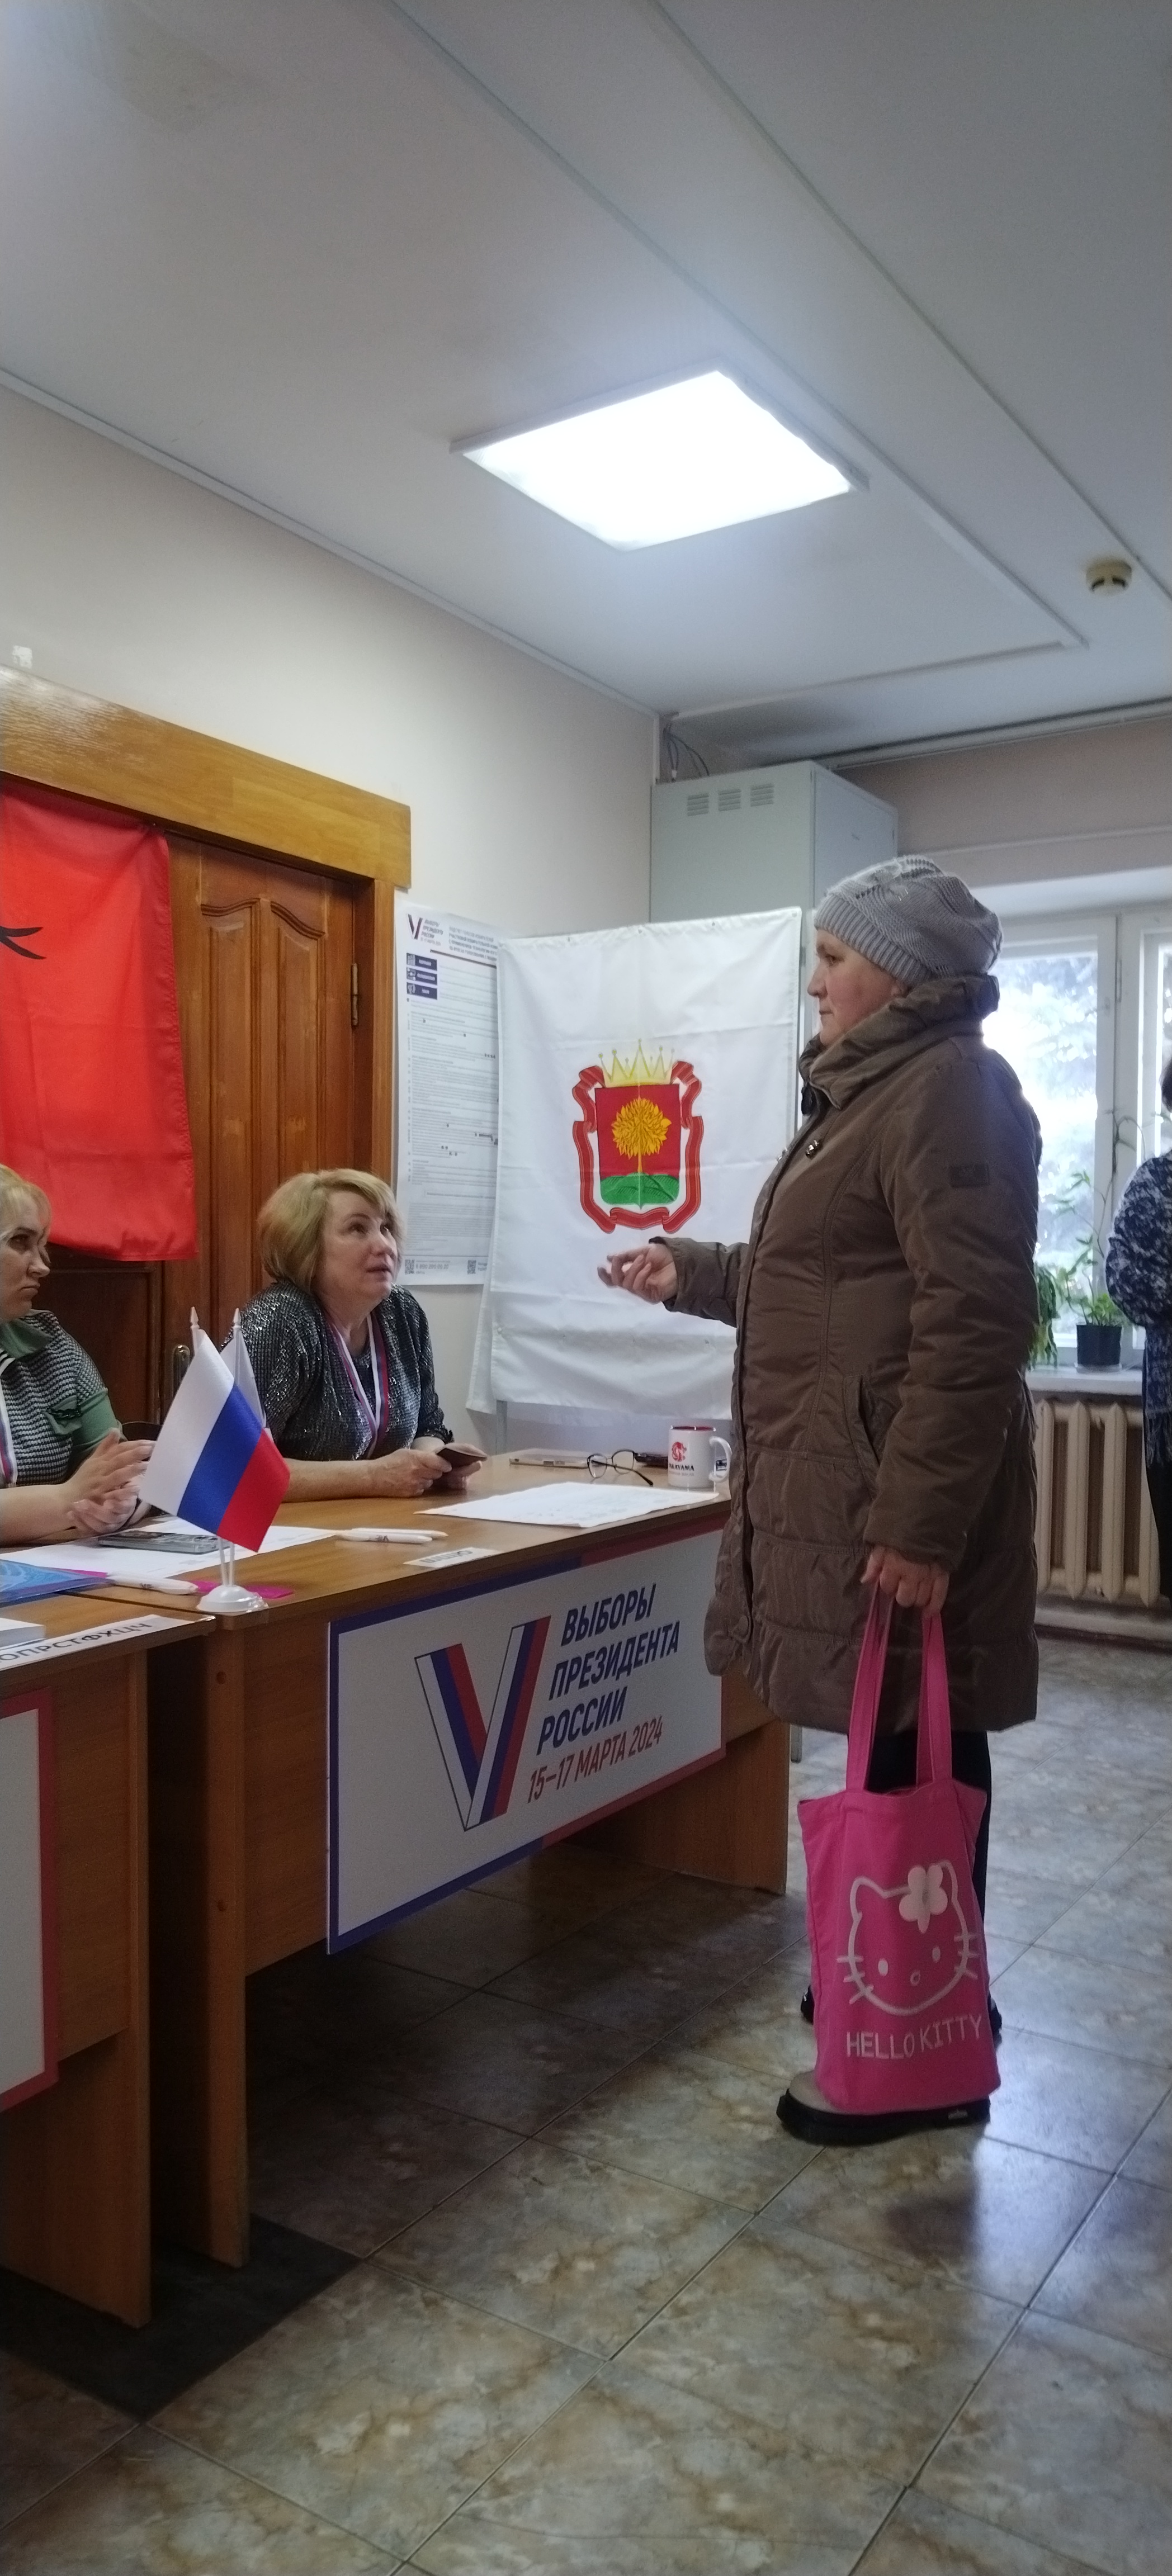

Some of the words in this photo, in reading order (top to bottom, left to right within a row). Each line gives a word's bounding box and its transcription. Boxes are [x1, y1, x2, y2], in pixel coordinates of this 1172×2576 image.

[0, 1623, 152, 1663] ОПРСТФХЦЧ
[561, 1583, 656, 1646] ВЫБОРЫ
[548, 1620, 680, 1701] ПРЕЗИДЕНТА
[536, 1686, 628, 1756] РОССИИ
[574, 1730, 627, 1782] МАРТА
[627, 1715, 663, 1758] 2024
[847, 2030, 914, 2059] HELLO
[920, 2014, 983, 2053] KITTY
